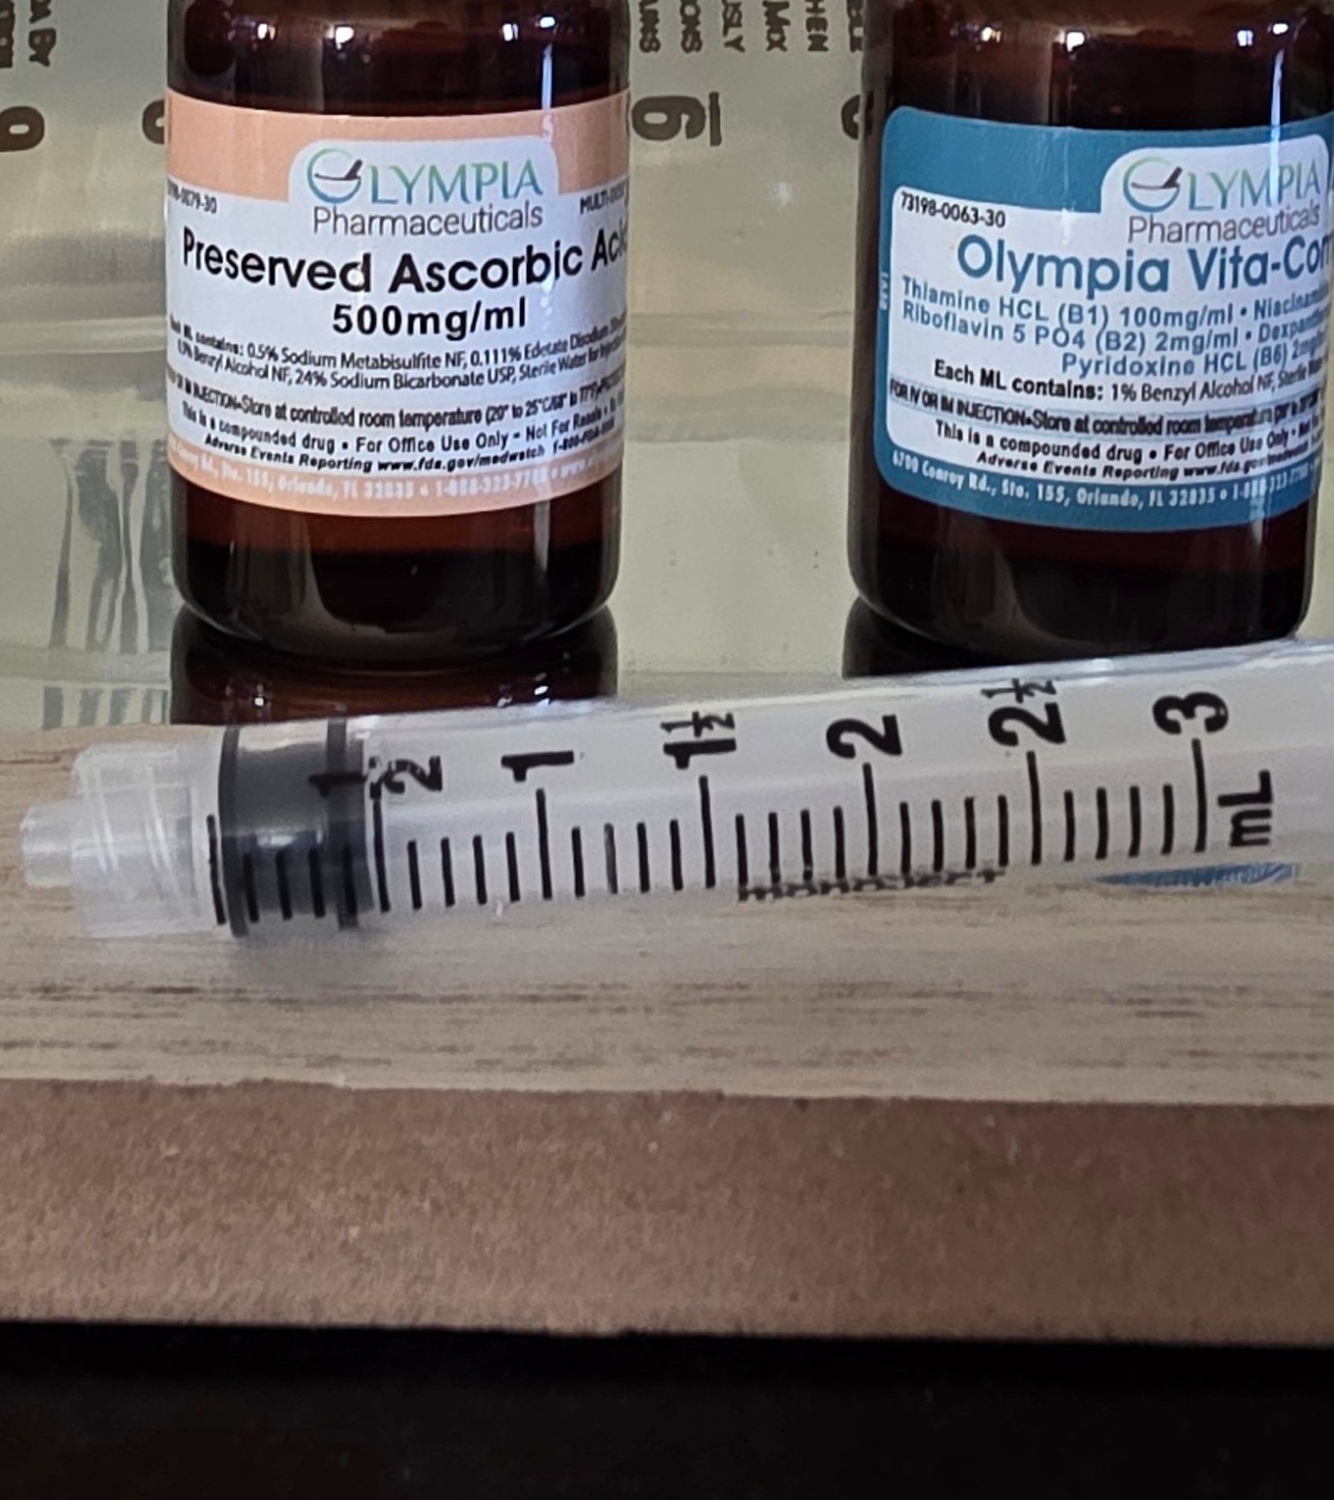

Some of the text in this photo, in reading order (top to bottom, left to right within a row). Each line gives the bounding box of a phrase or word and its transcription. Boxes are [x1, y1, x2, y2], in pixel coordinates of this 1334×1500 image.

[762, 0, 791, 52] MIX
[631, 94, 706, 142] 6
[313, 201, 544, 237] Pharmaceuticals
[1128, 199, 1321, 244] Pharmaceuticals
[183, 224, 372, 293] Preserved
[387, 239, 584, 294] Ascorbic
[957, 233, 1170, 301] Olympia
[331, 297, 528, 343] 500mg/ml
[902, 275, 991, 315] Thiamine
[999, 297, 1049, 322] HCL
[1058, 302, 1110, 333] (B1)
[1119, 302, 1234, 332] 100mg/ml
[903, 300, 1239, 357] Riboflavin 5 PO4 (B2) 2mg/ml
[224, 357, 557, 391] Alcohol NF, 24% Sodium Bicarbonate USP, Sterile
[247, 343, 279, 362] 0.5%
[281, 347, 337, 369] Sodium
[340, 350, 442, 372] Metabisulfite
[444, 351, 468, 371] NF,
[470, 346, 523, 367] 0.111%
[1062, 342, 1288, 379] Pyridoxine HCL (B6)
[933, 358, 1255, 406] Each ML contains: 1% Benzyl Alcohol
[290, 405, 482, 432] controlled room temperature
[921, 389, 938, 409] OR
[1092, 415, 1164, 437] controlled
[1166, 417, 1201, 435] room
[218, 418, 297, 449] compounded
[301, 431, 335, 455] drug
[355, 437, 383, 454] For
[387, 436, 436, 455] Office
[440, 434, 470, 452] Use
[475, 430, 510, 450] Only
[250, 445, 295, 465] Events
[298, 452, 373, 474] Reporting
[934, 419, 964, 442] This
[968, 426, 981, 447] is
[999, 433, 1101, 461] compounded
[1105, 443, 1143, 465] drug
[1163, 443, 1191, 461] For
[1194, 440, 1236, 459] Office
[1239, 435, 1264, 454] Use
[976, 451, 1180, 482] Adverse Events Reporting
[500, 750, 575, 783] 1
[825, 713, 904, 759] 2
[1151, 690, 1230, 735] 3
[1216, 769, 1275, 849] mL
